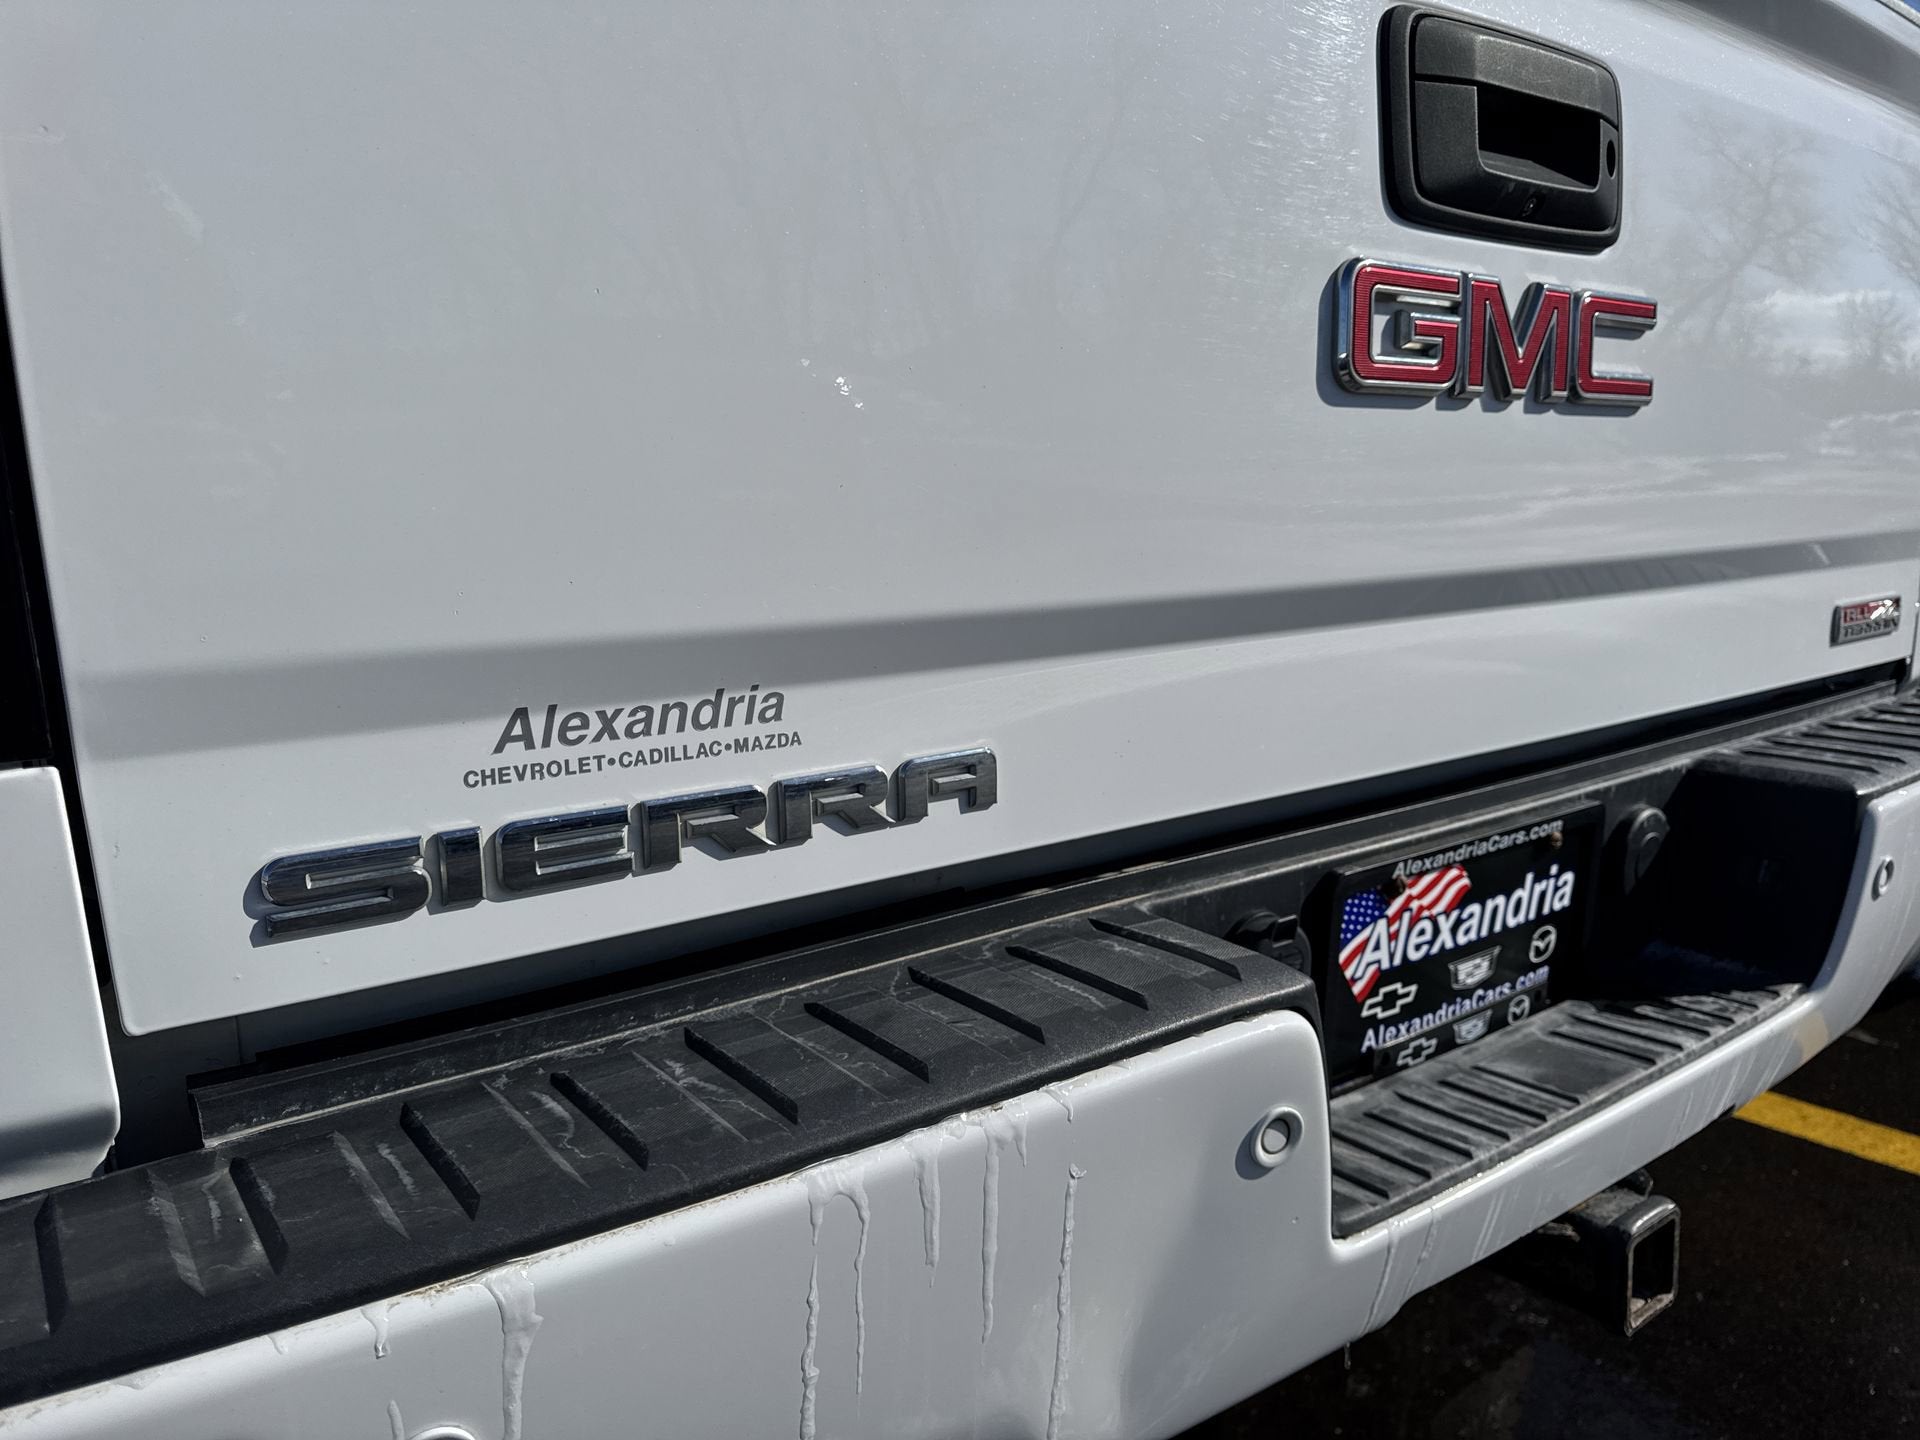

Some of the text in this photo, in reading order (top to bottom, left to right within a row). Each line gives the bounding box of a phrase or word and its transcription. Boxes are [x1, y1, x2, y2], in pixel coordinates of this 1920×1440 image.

[1335, 255, 1657, 408] GMC
[490, 684, 785, 756] Alexandria
[260, 746, 998, 938] SIERRA
[1392, 819, 1564, 879] AlexandriaCars.com
[1353, 864, 1576, 980] Alexandria
[1360, 965, 1550, 1053] AlexandriaCars.com
